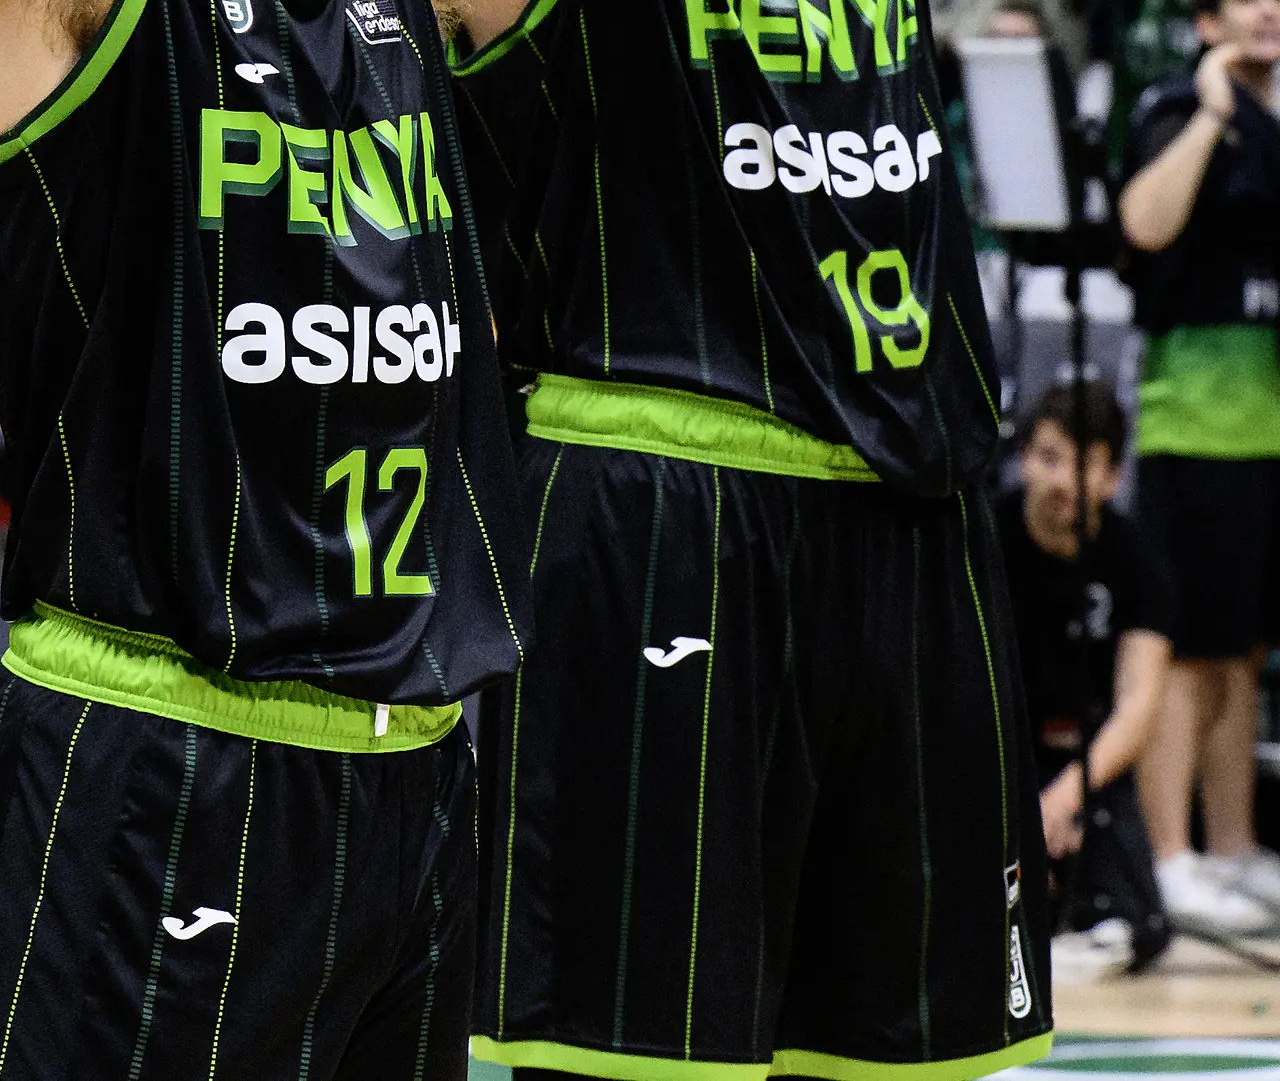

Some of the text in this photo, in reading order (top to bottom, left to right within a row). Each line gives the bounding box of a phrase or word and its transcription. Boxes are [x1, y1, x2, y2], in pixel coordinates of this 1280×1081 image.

[352, 0, 380, 19] liga
[197, 107, 454, 247] PENYA
[818, 247, 931, 374] 19
[323, 445, 437, 598] 12
